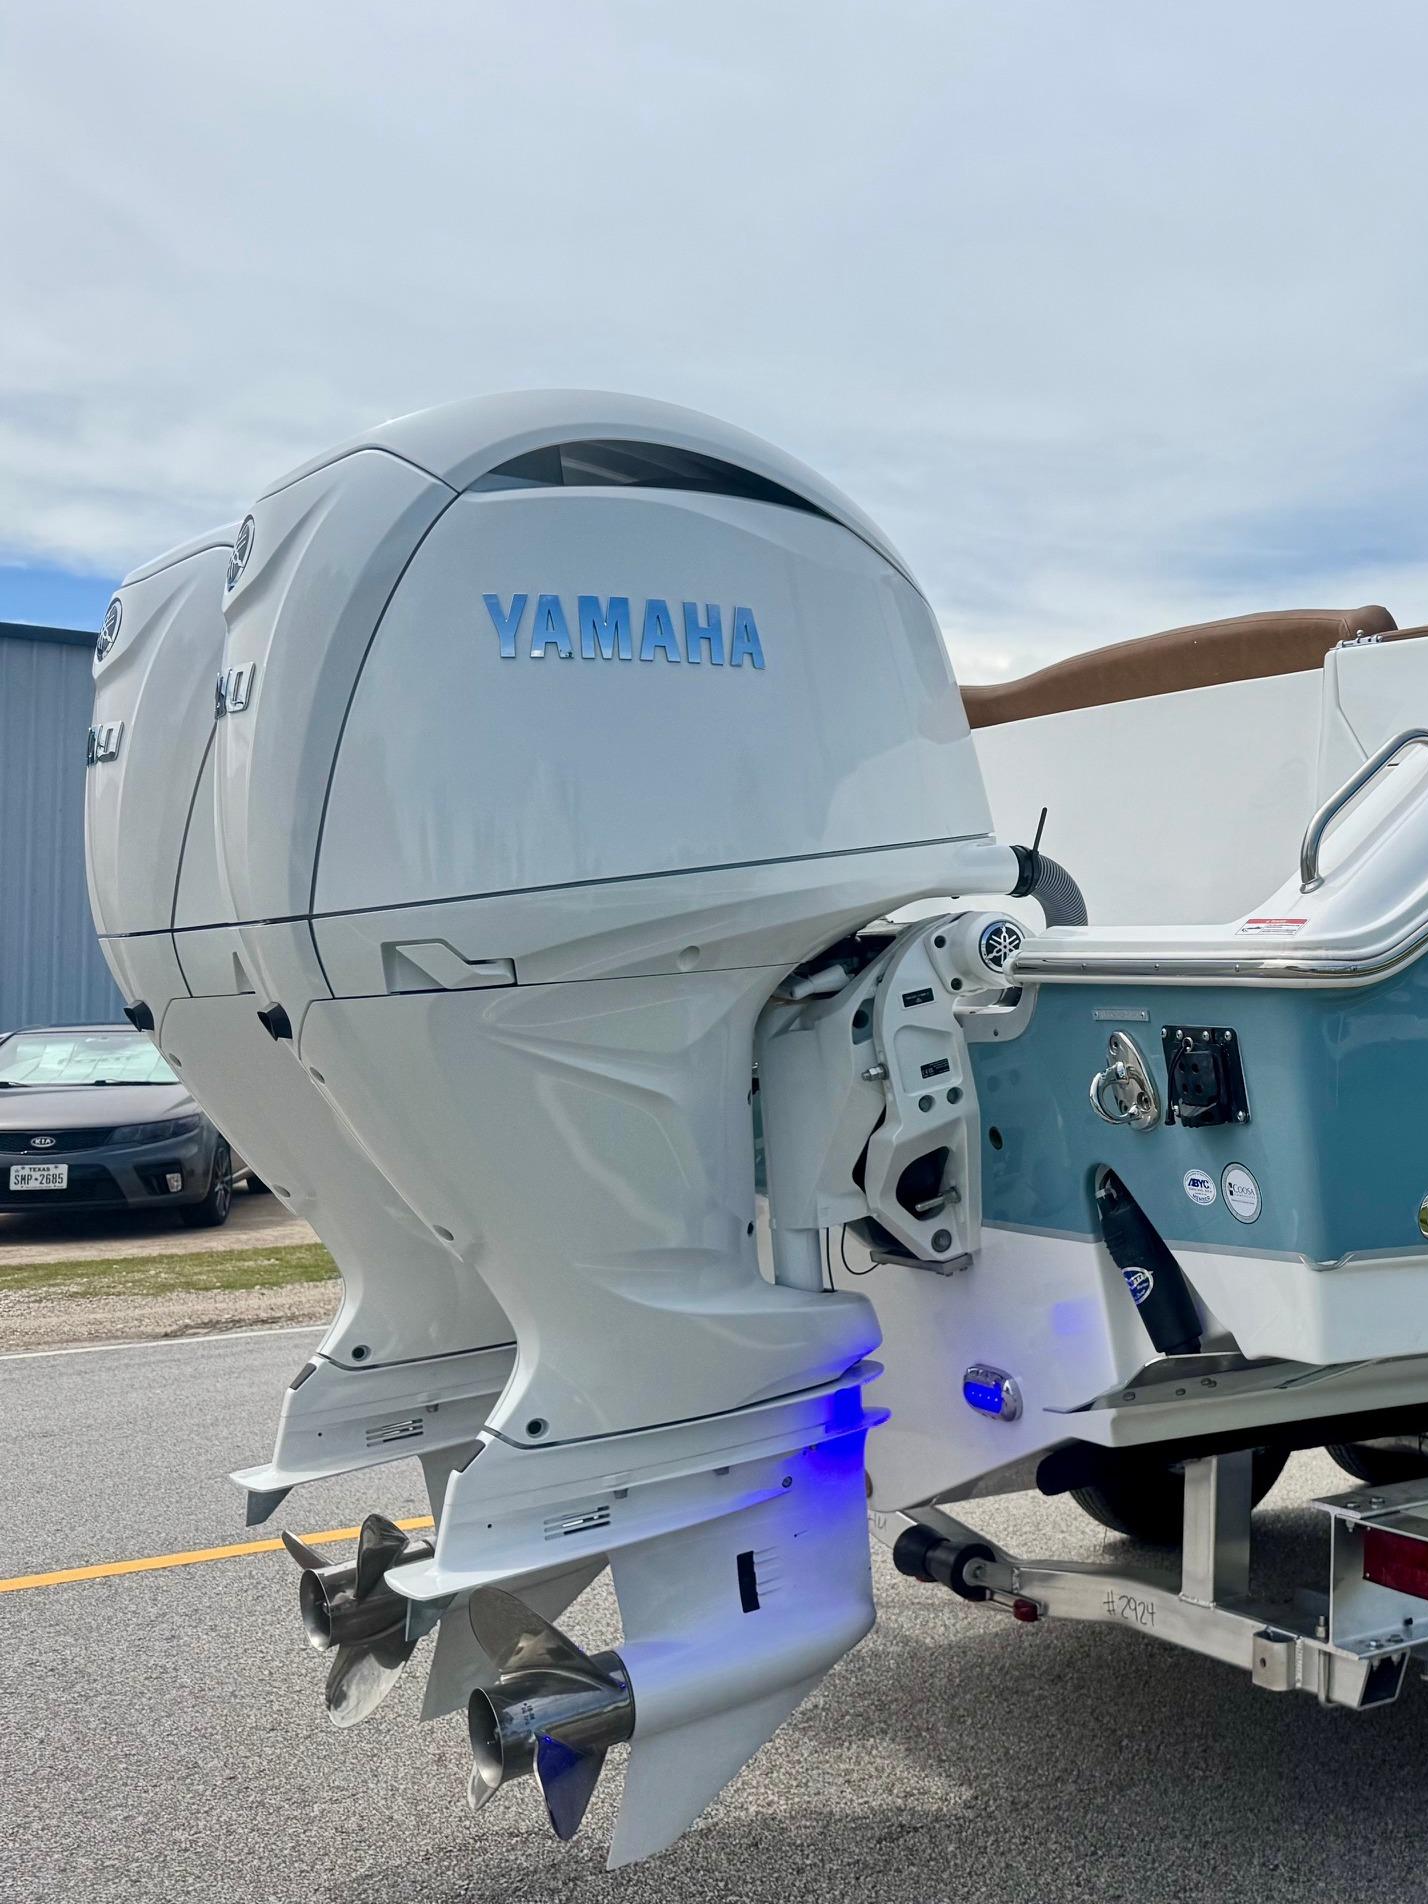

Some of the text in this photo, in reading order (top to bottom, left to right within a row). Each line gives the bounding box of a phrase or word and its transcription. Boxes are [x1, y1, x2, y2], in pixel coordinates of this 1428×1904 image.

[482, 593, 766, 670] YAMAHA
[1187, 1178, 1210, 1189] ABYC
[1102, 1589, 1157, 1627] #2924
